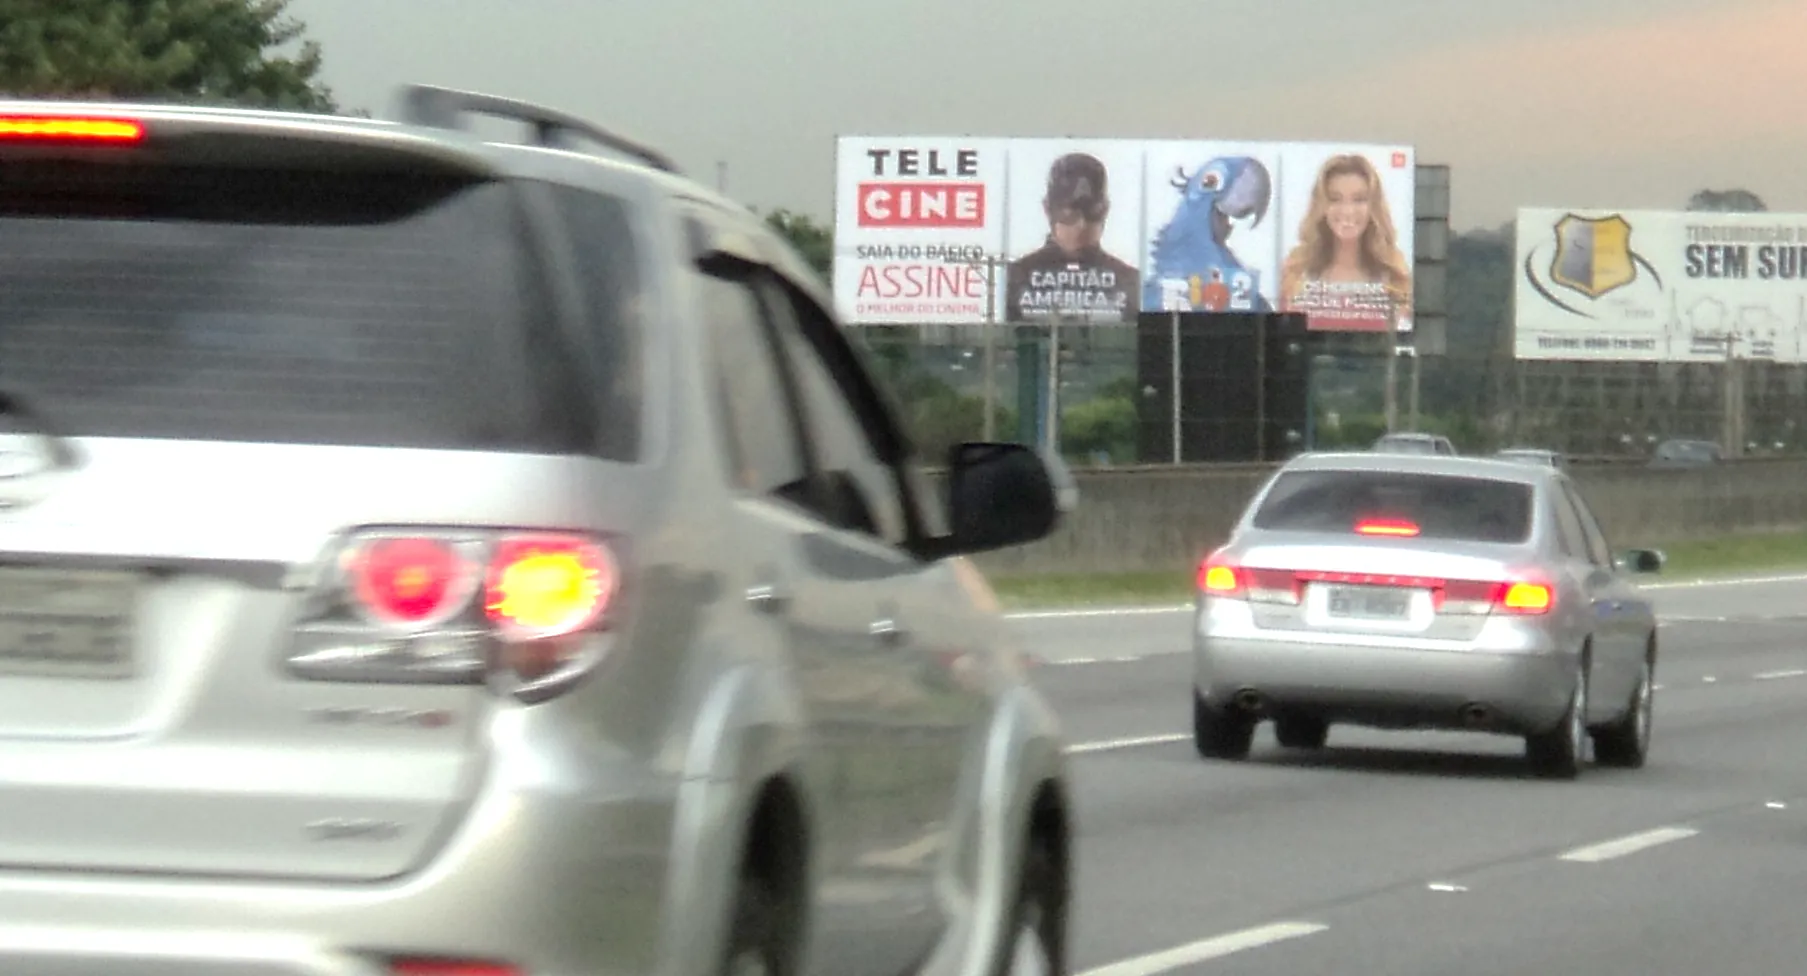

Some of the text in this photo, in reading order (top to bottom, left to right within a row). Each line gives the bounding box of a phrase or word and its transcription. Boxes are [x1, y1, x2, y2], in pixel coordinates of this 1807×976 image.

[867, 149, 978, 176] TELE
[864, 190, 978, 220] CINE
[857, 245, 893, 259] SAIA
[899, 245, 921, 259] DO
[1686, 244, 1748, 278] SEM
[857, 265, 983, 298] ASSINE
[1031, 268, 1116, 288] CAPITÃO
[1231, 271, 1251, 309] 2
[1116, 291, 1127, 308] 2
